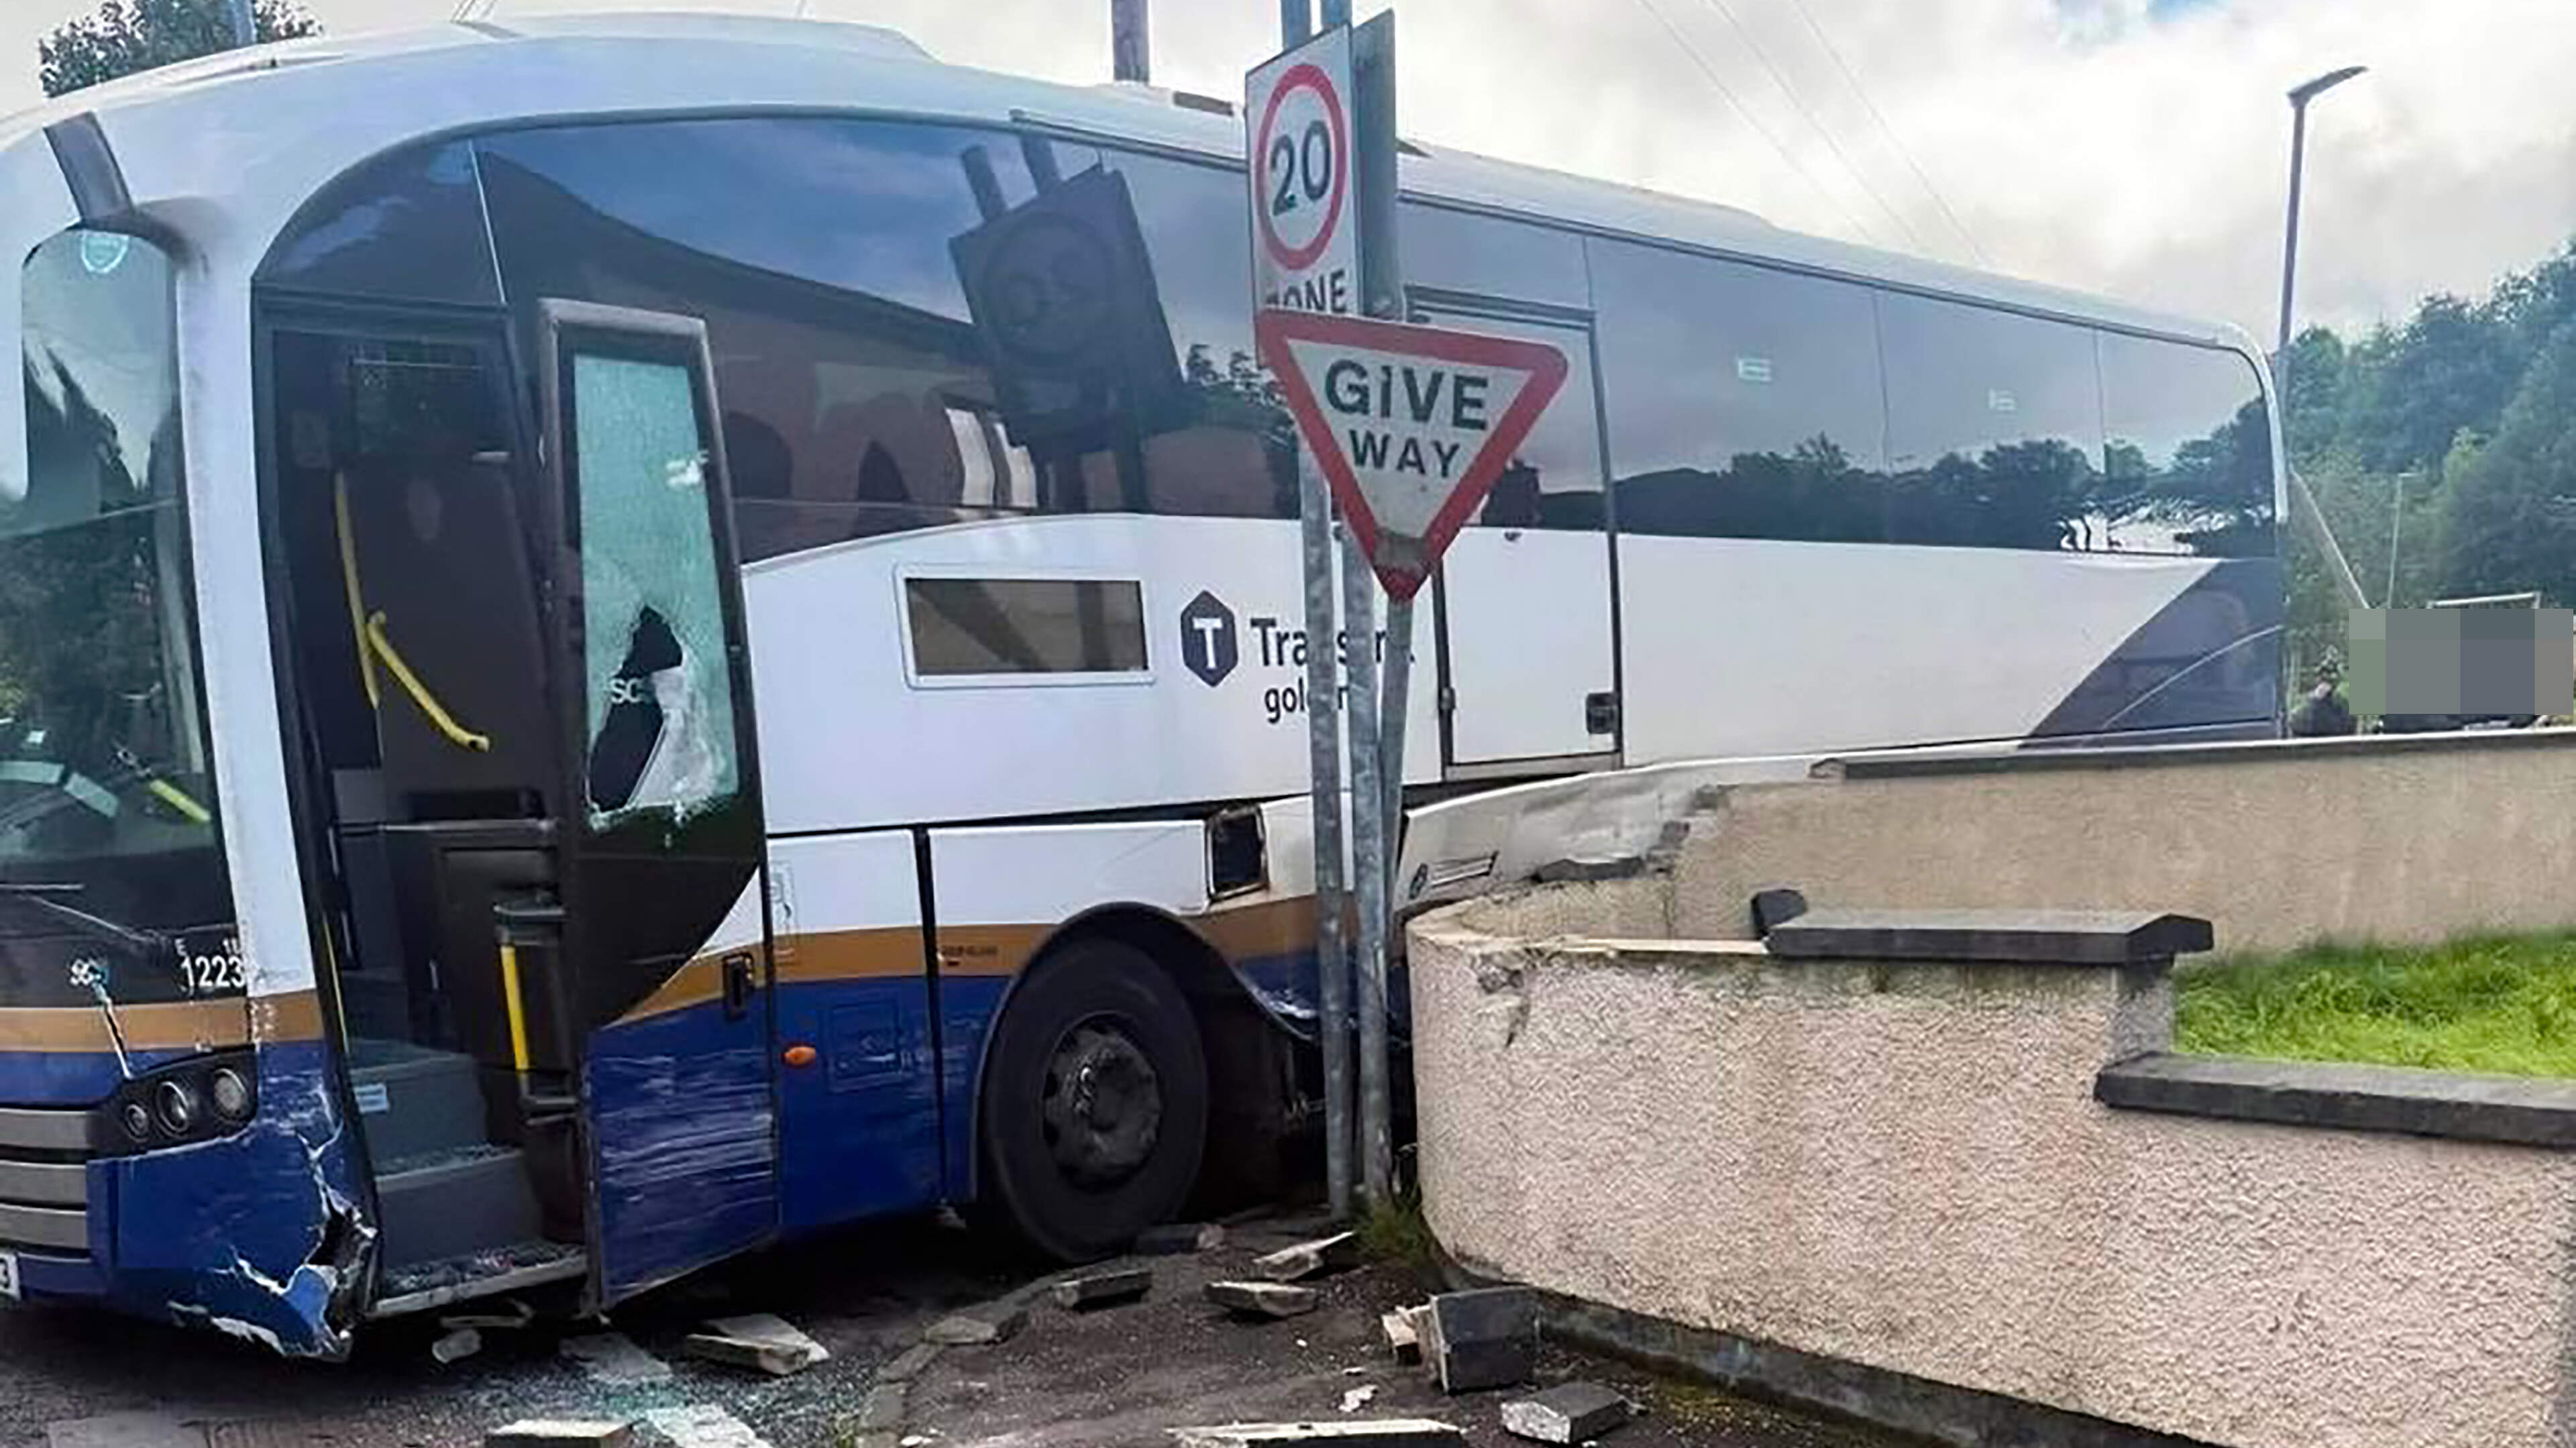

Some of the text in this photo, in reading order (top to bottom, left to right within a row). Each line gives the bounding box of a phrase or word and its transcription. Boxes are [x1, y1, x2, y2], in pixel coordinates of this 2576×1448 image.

[1269, 119, 1332, 217] 20
[1265, 268, 1347, 314] ONE
[1324, 359, 1490, 431] GIVE
[1348, 429, 1462, 480] WAY
[180, 955, 246, 988] 1223
